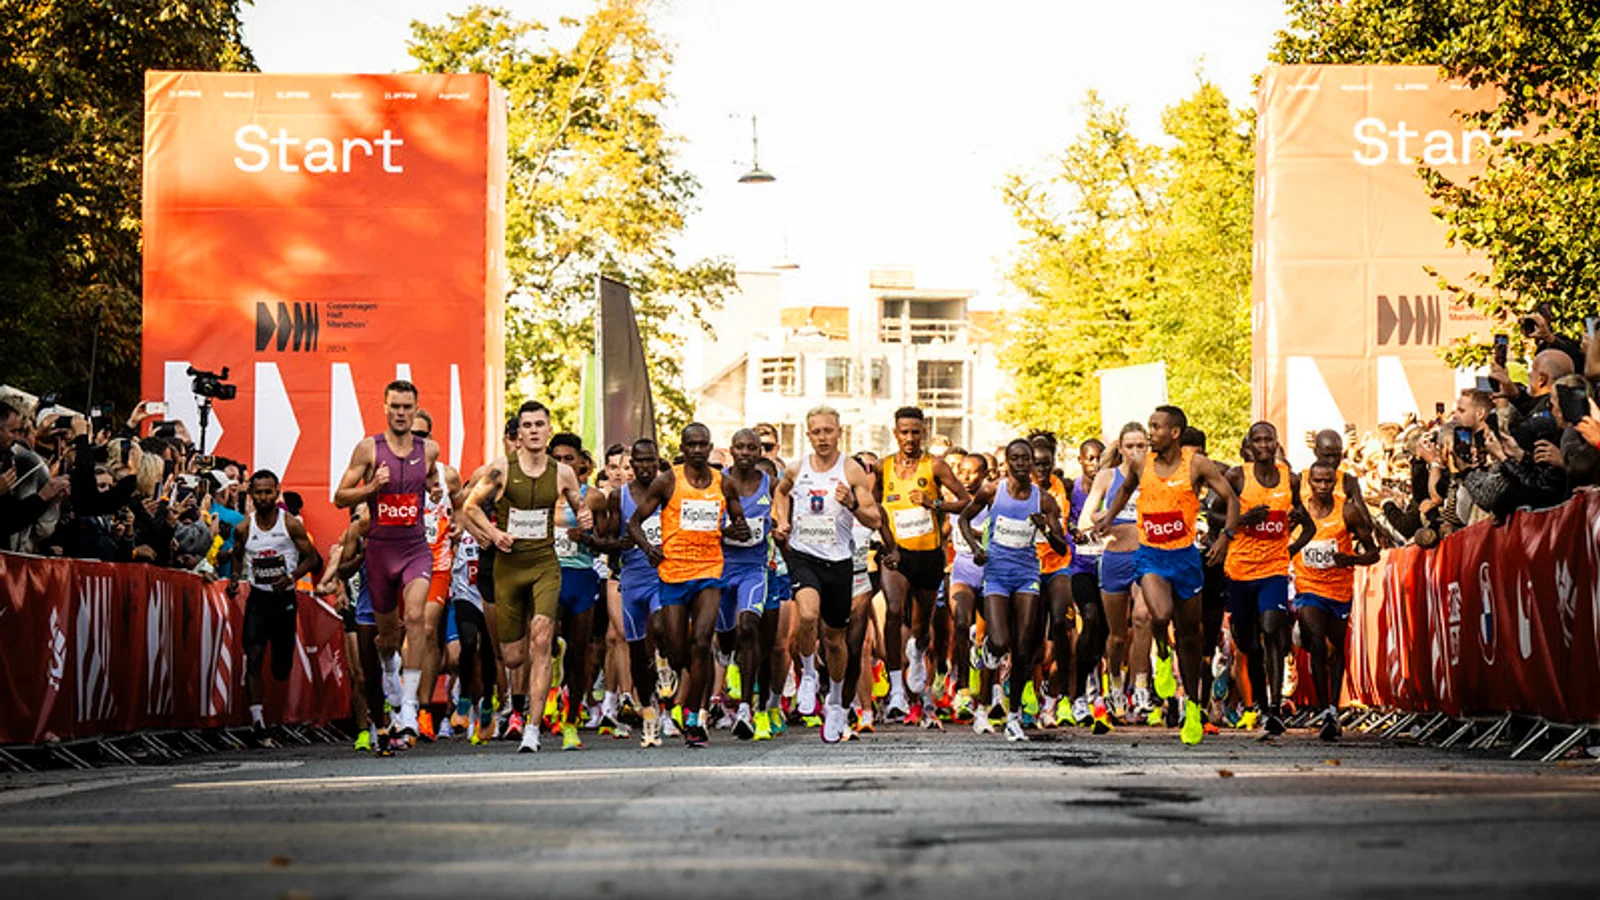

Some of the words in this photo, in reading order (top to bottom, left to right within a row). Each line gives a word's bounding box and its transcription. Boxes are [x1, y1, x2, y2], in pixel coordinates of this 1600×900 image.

[234, 124, 404, 173] Start
[378, 503, 418, 518] Pace
[1144, 519, 1184, 537] Pace
[1254, 520, 1285, 534] ace
